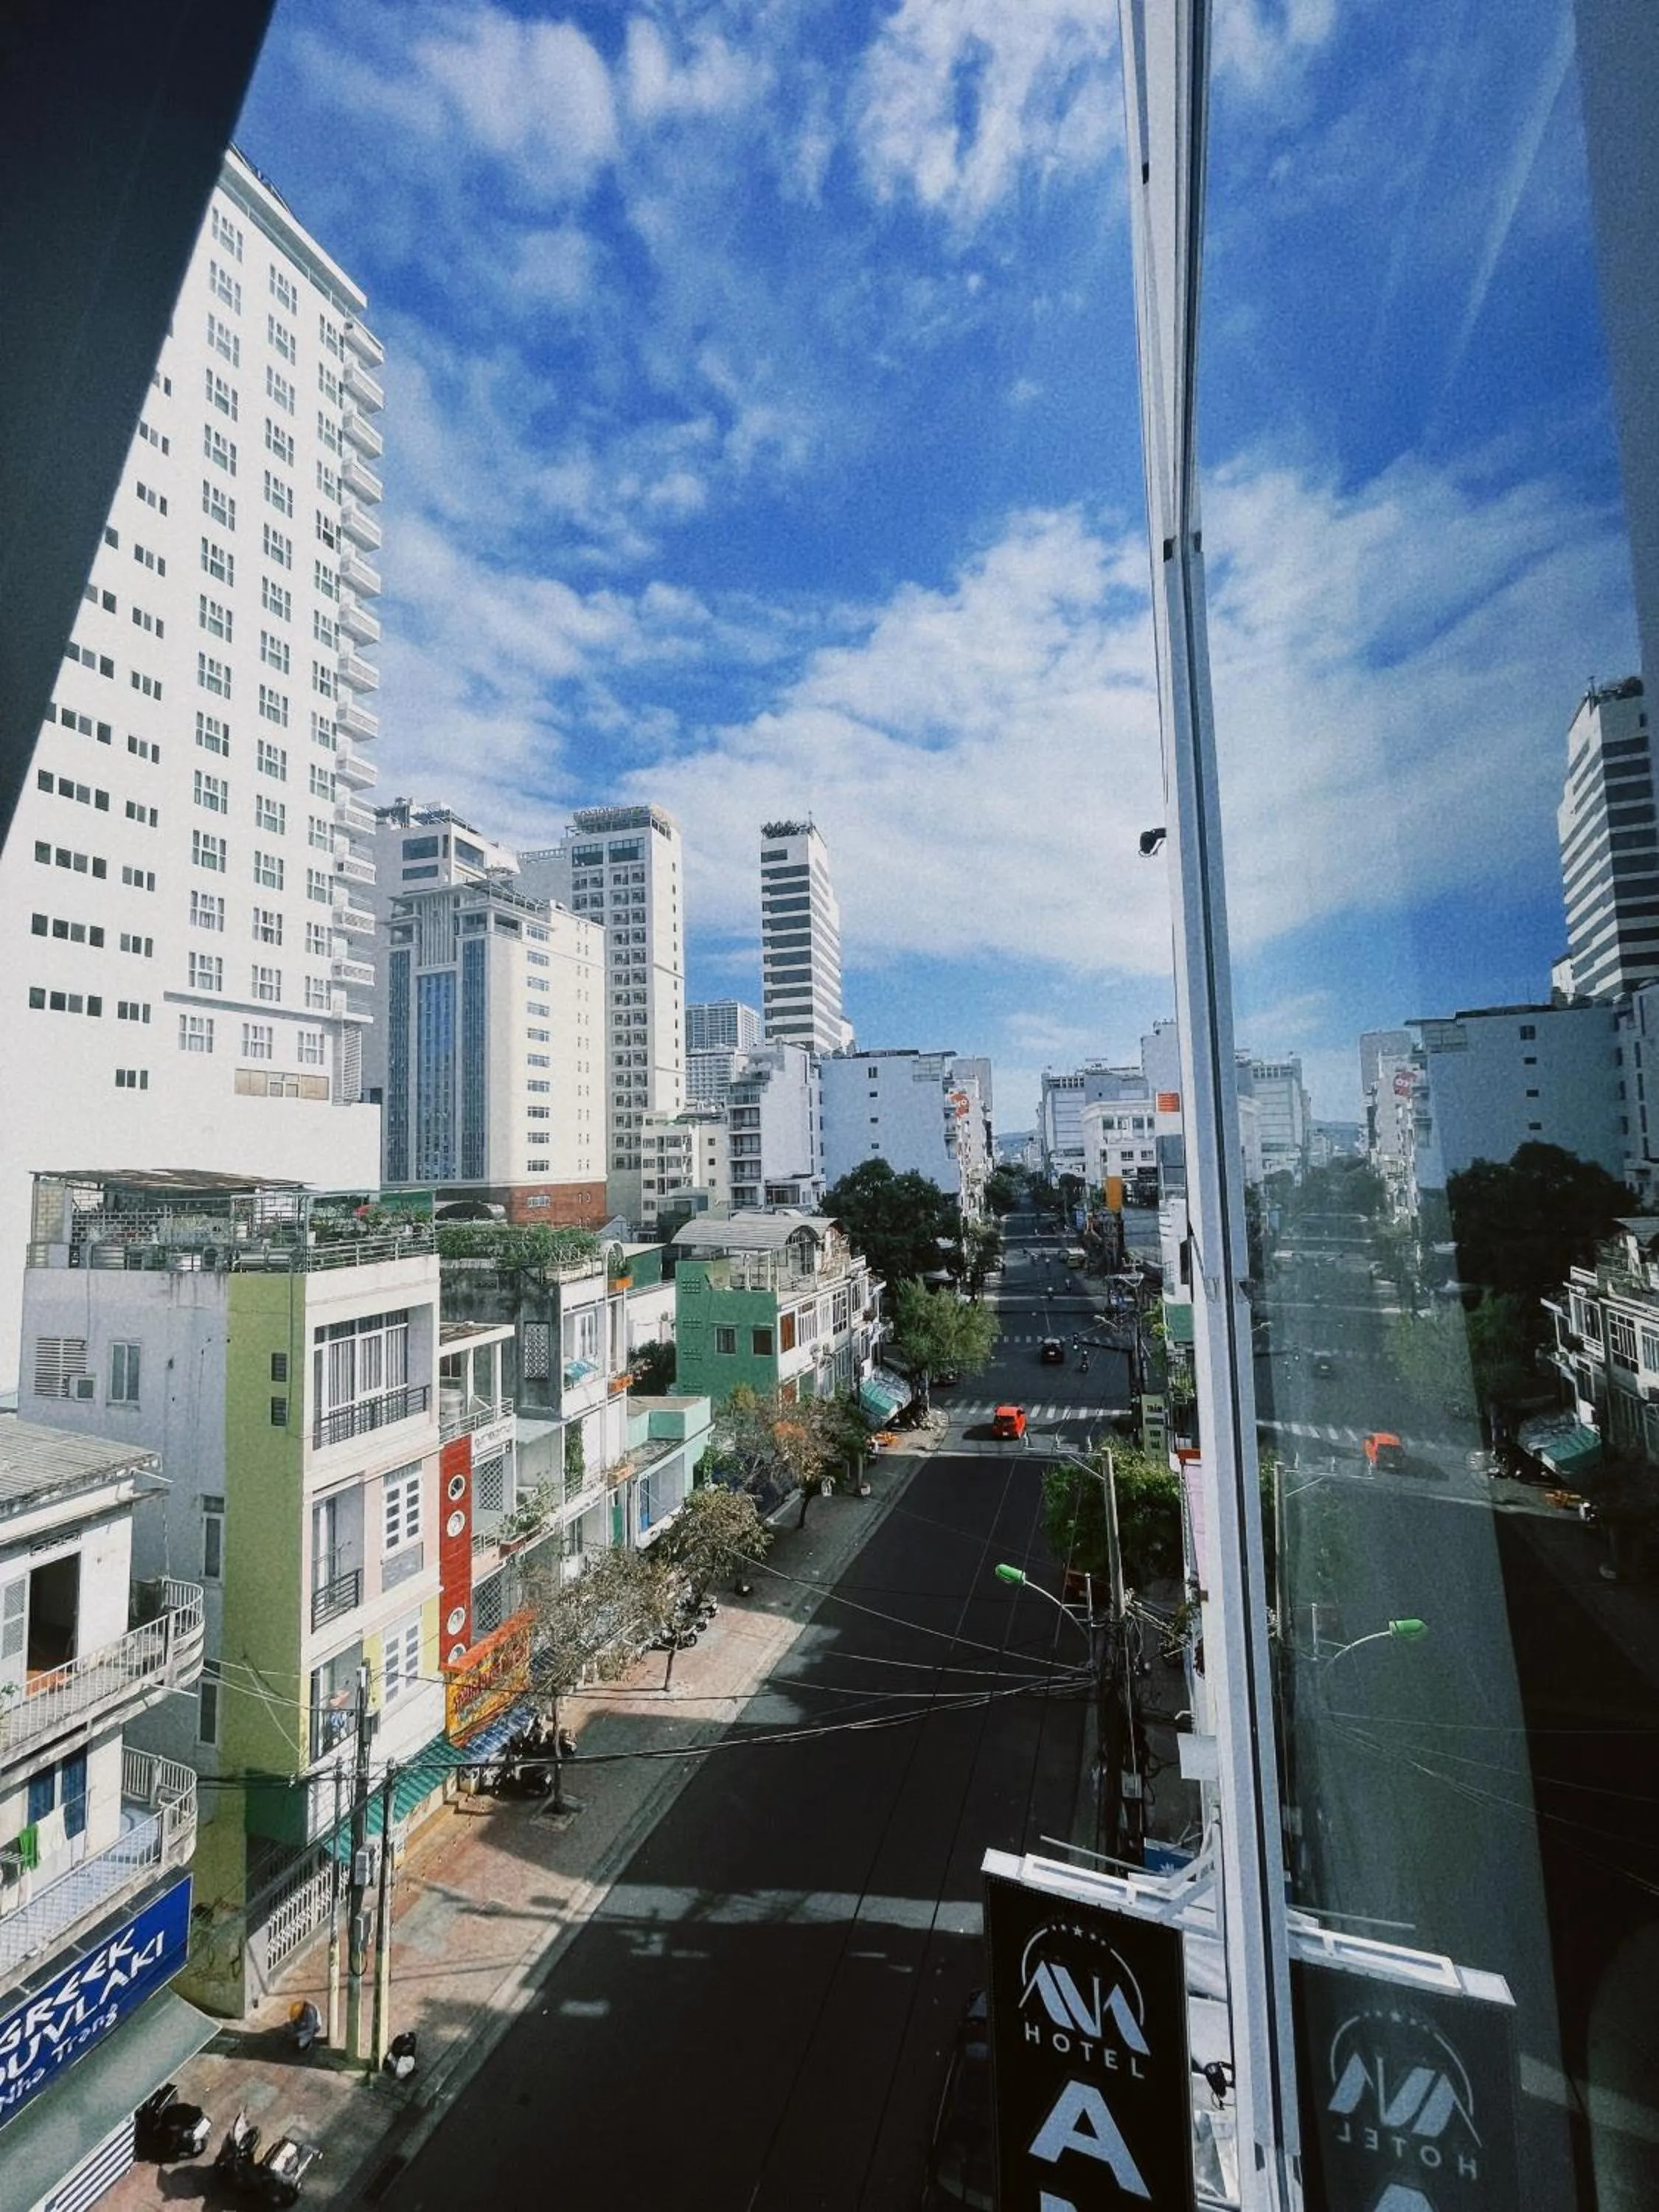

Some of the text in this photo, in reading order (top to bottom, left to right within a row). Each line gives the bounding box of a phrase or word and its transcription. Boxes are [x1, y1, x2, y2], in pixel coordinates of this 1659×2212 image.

[0, 1930, 164, 2087] UVLAKI
[52, 2003, 119, 2062] Trang
[1024, 2021, 1145, 2079] HOTEL
